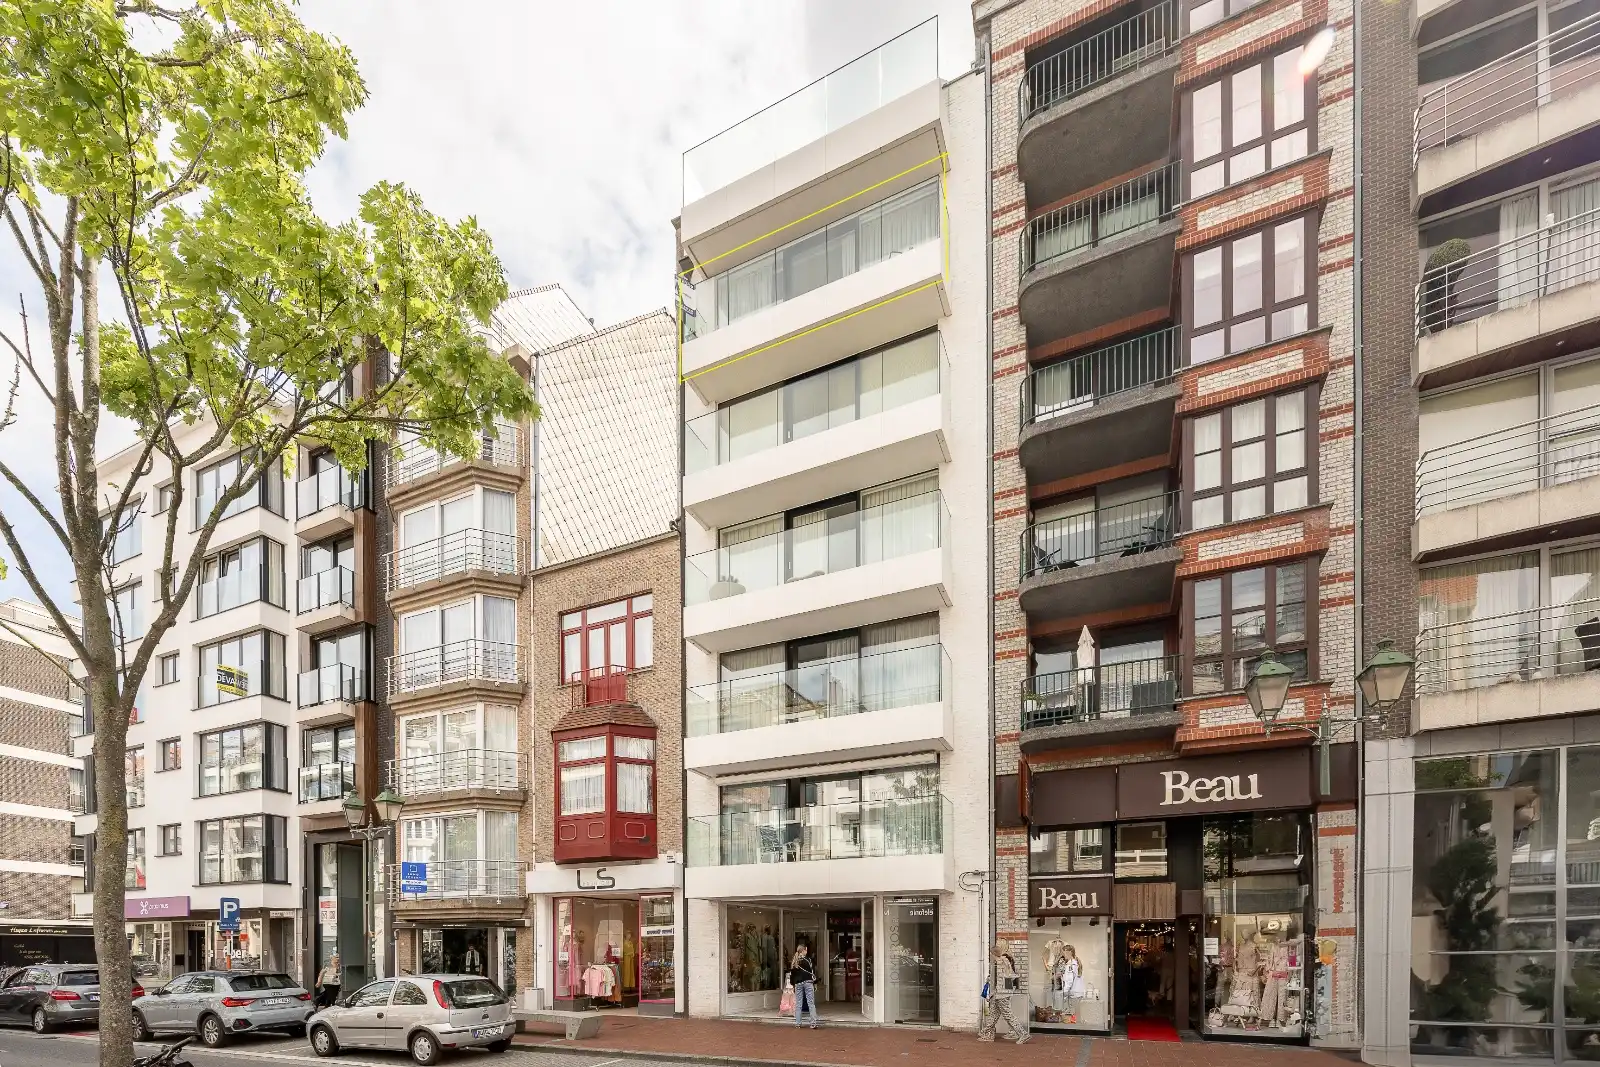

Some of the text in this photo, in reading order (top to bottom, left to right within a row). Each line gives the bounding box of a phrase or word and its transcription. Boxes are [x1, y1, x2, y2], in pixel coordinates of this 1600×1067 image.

[1160, 770, 1262, 805] Beau
[577, 868, 616, 889] LS
[1038, 887, 1100, 910] Beau
[223, 901, 238, 919] P
